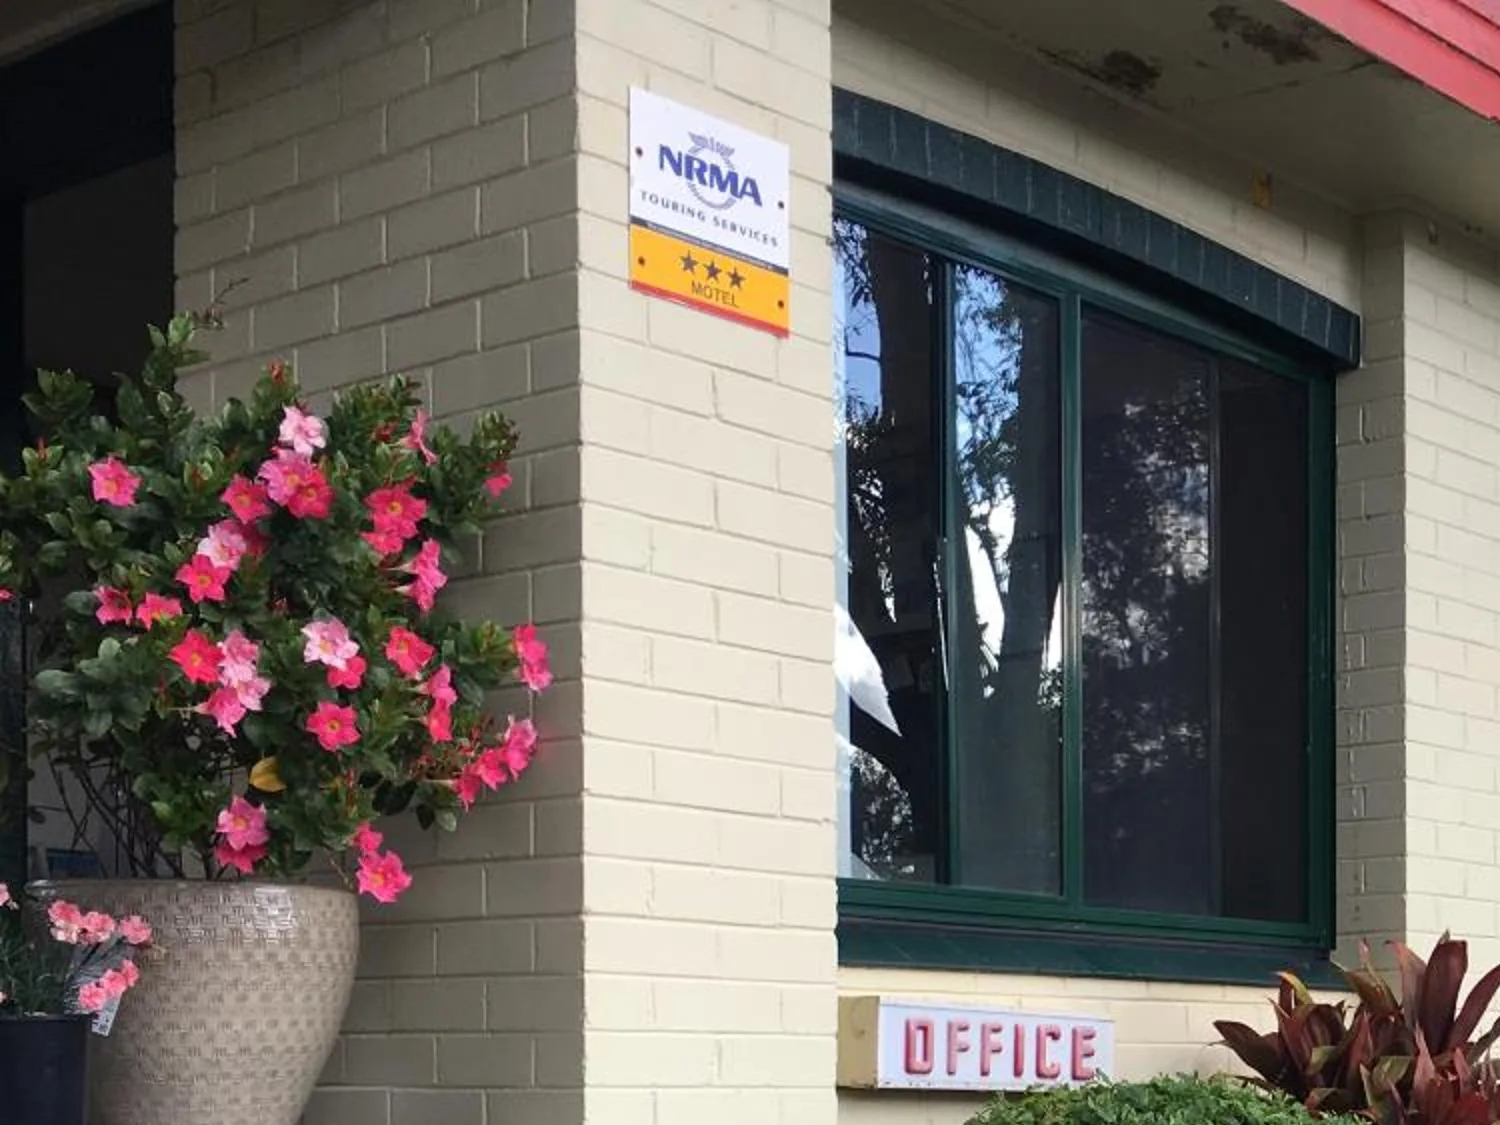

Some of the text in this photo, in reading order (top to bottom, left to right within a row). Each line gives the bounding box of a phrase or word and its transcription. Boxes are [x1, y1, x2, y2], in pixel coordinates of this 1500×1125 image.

[659, 144, 762, 207] NRMA
[641, 190, 706, 221] TOURING
[713, 216, 778, 247] SERVICES
[691, 280, 739, 308] MOTEL
[905, 1017, 1097, 1080] OFFICE
